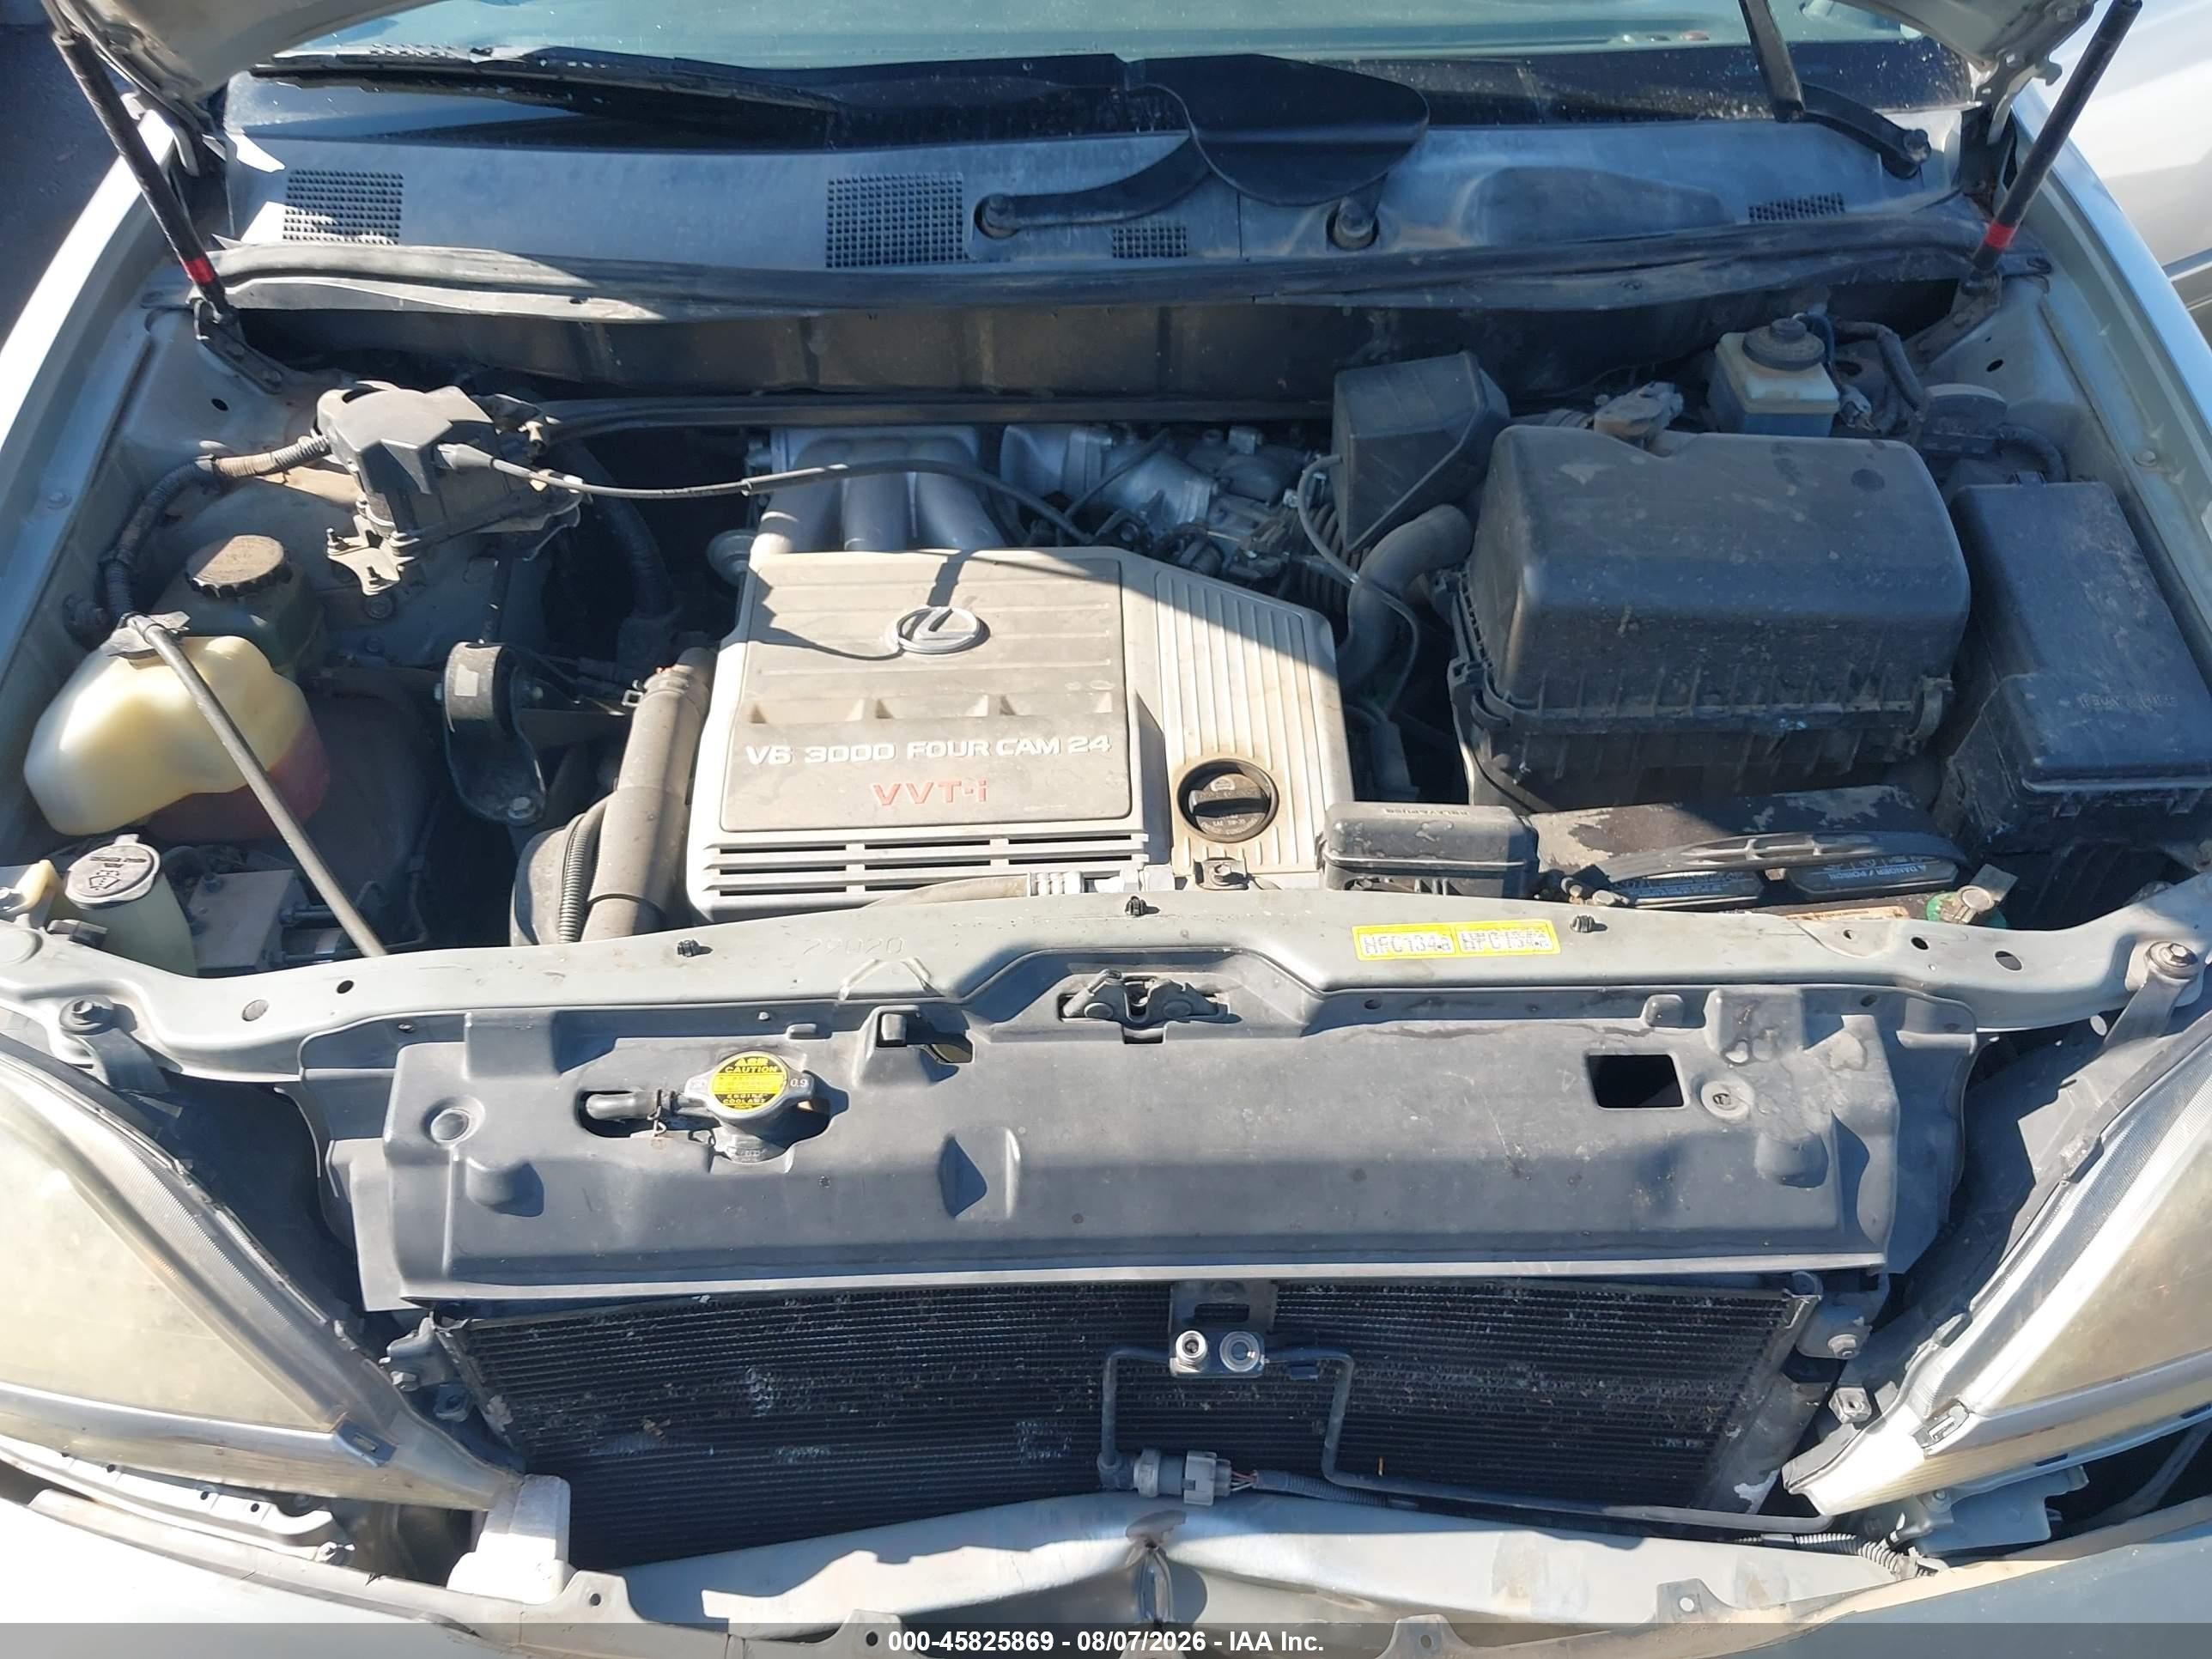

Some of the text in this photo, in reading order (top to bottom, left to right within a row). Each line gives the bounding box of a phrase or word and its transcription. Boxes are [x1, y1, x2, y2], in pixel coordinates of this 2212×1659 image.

[745, 735, 1113, 765] V6 3000 FOUR CAM 24
[873, 780, 988, 806] VVT-i
[790, 1079, 809, 1087] 0.9
